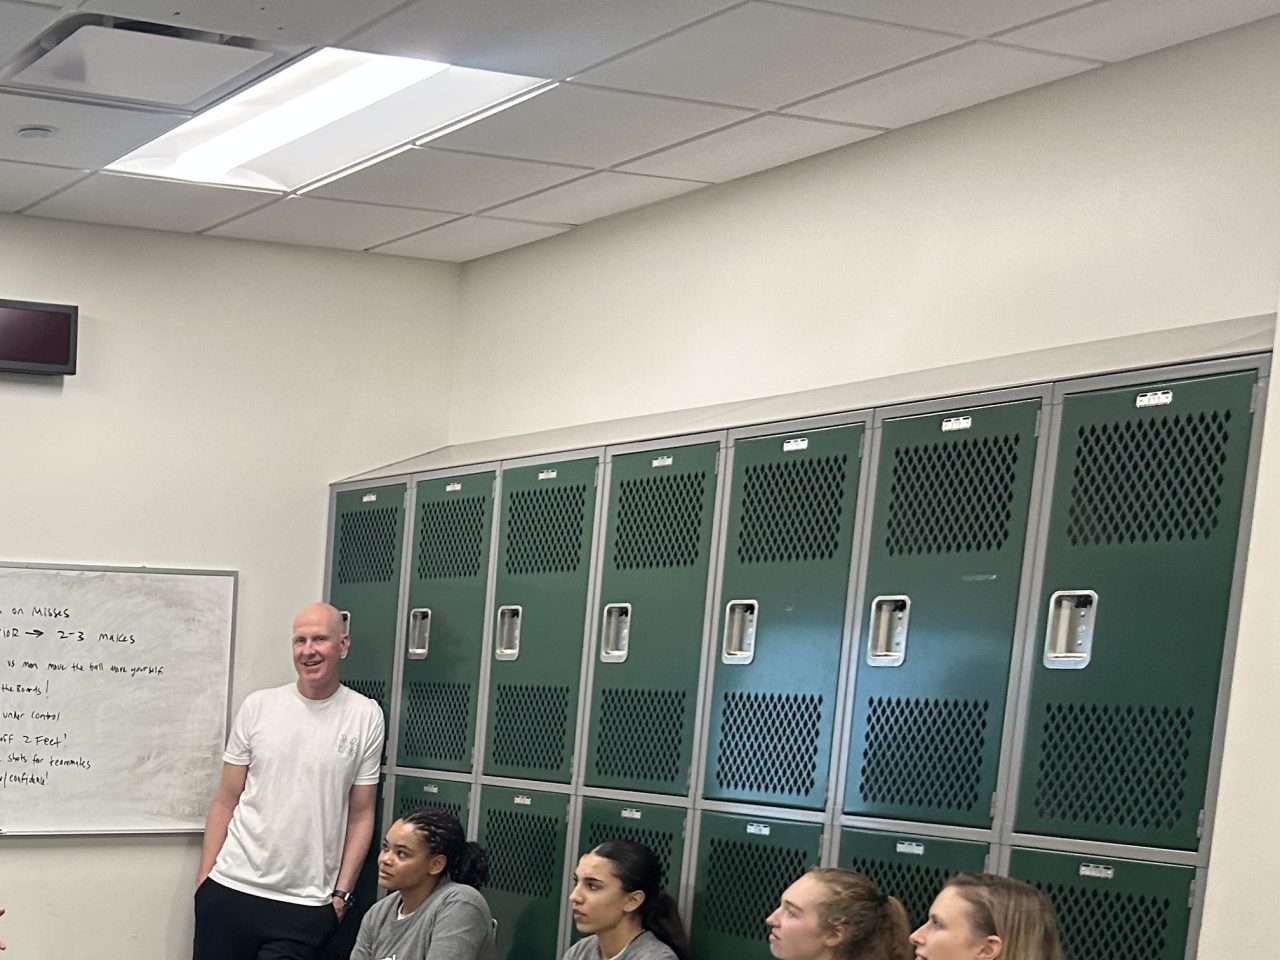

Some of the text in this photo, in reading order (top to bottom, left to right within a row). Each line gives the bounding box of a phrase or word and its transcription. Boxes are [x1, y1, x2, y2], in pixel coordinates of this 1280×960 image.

[11, 607, 24, 615] on
[57, 630, 85, 642] 2-3
[72, 662, 84, 671] the
[89, 661, 104, 671] ball
[1, 683, 14, 692] the
[22, 735, 32, 743] 2
[32, 753, 44, 764] for
